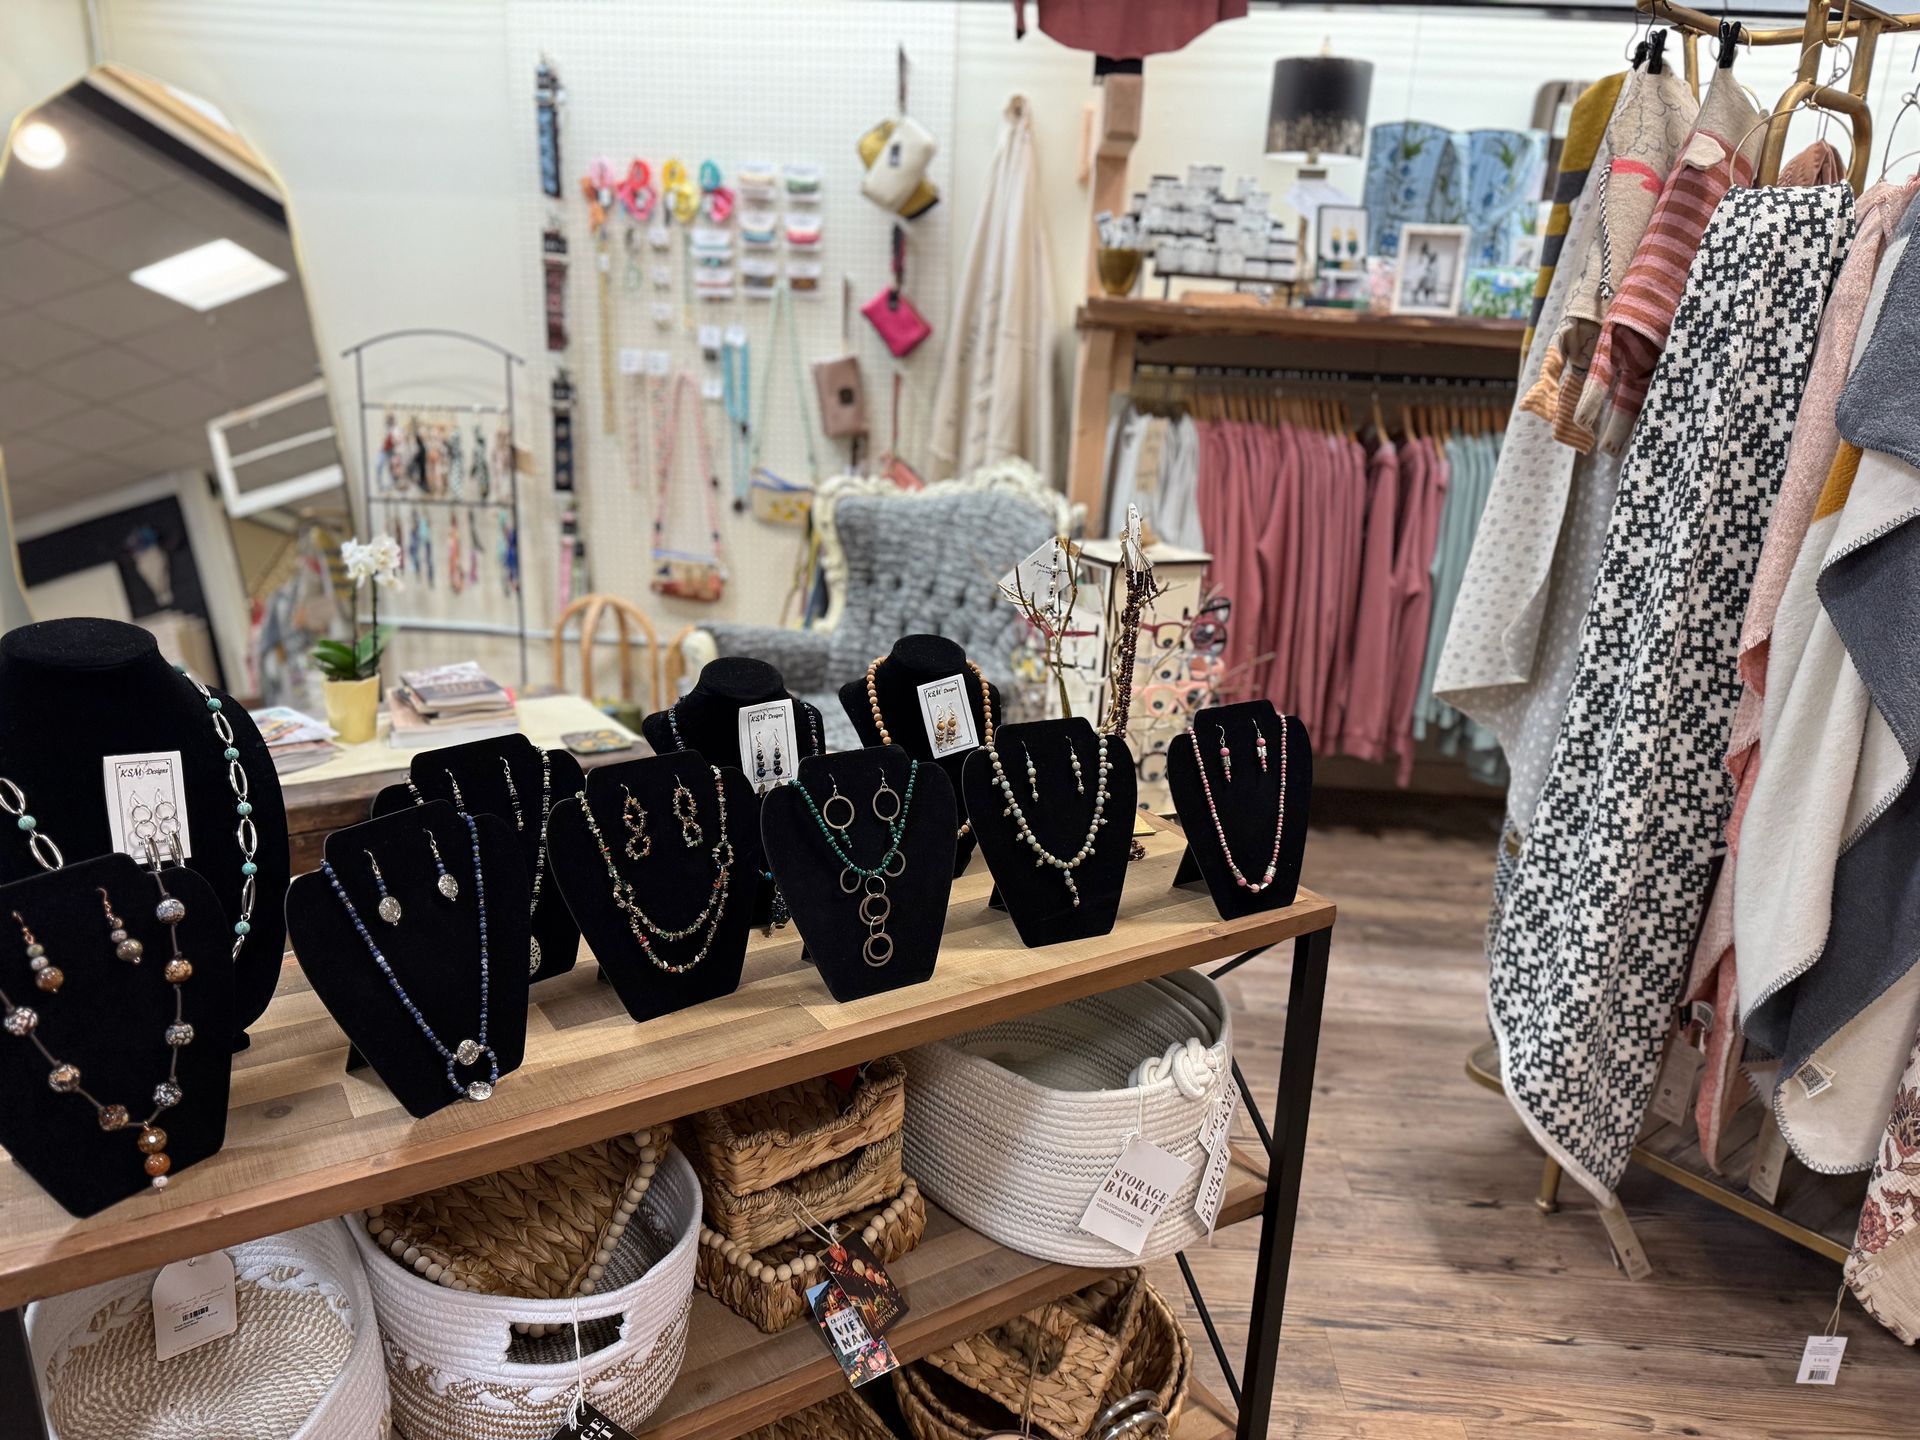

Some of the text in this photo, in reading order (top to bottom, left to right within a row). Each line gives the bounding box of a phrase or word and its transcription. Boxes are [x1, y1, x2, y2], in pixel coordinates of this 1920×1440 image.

[120, 768, 142, 778] KSM
[1112, 1168, 1169, 1204] STORAGE
[1202, 1144, 1227, 1216] STORAGE
[1206, 1153, 1228, 1222] BASKET
[1104, 1180, 1162, 1216] BASKET
[1095, 1202, 1109, 1211] ROOMS
[1108, 1208, 1127, 1221] ORGANIZED
[1108, 1202, 1123, 1212] STORAGE
[1130, 1213, 1144, 1223] KEEPING
[874, 1305, 899, 1329] VIETNAM
[841, 1333, 871, 1350] NAM
